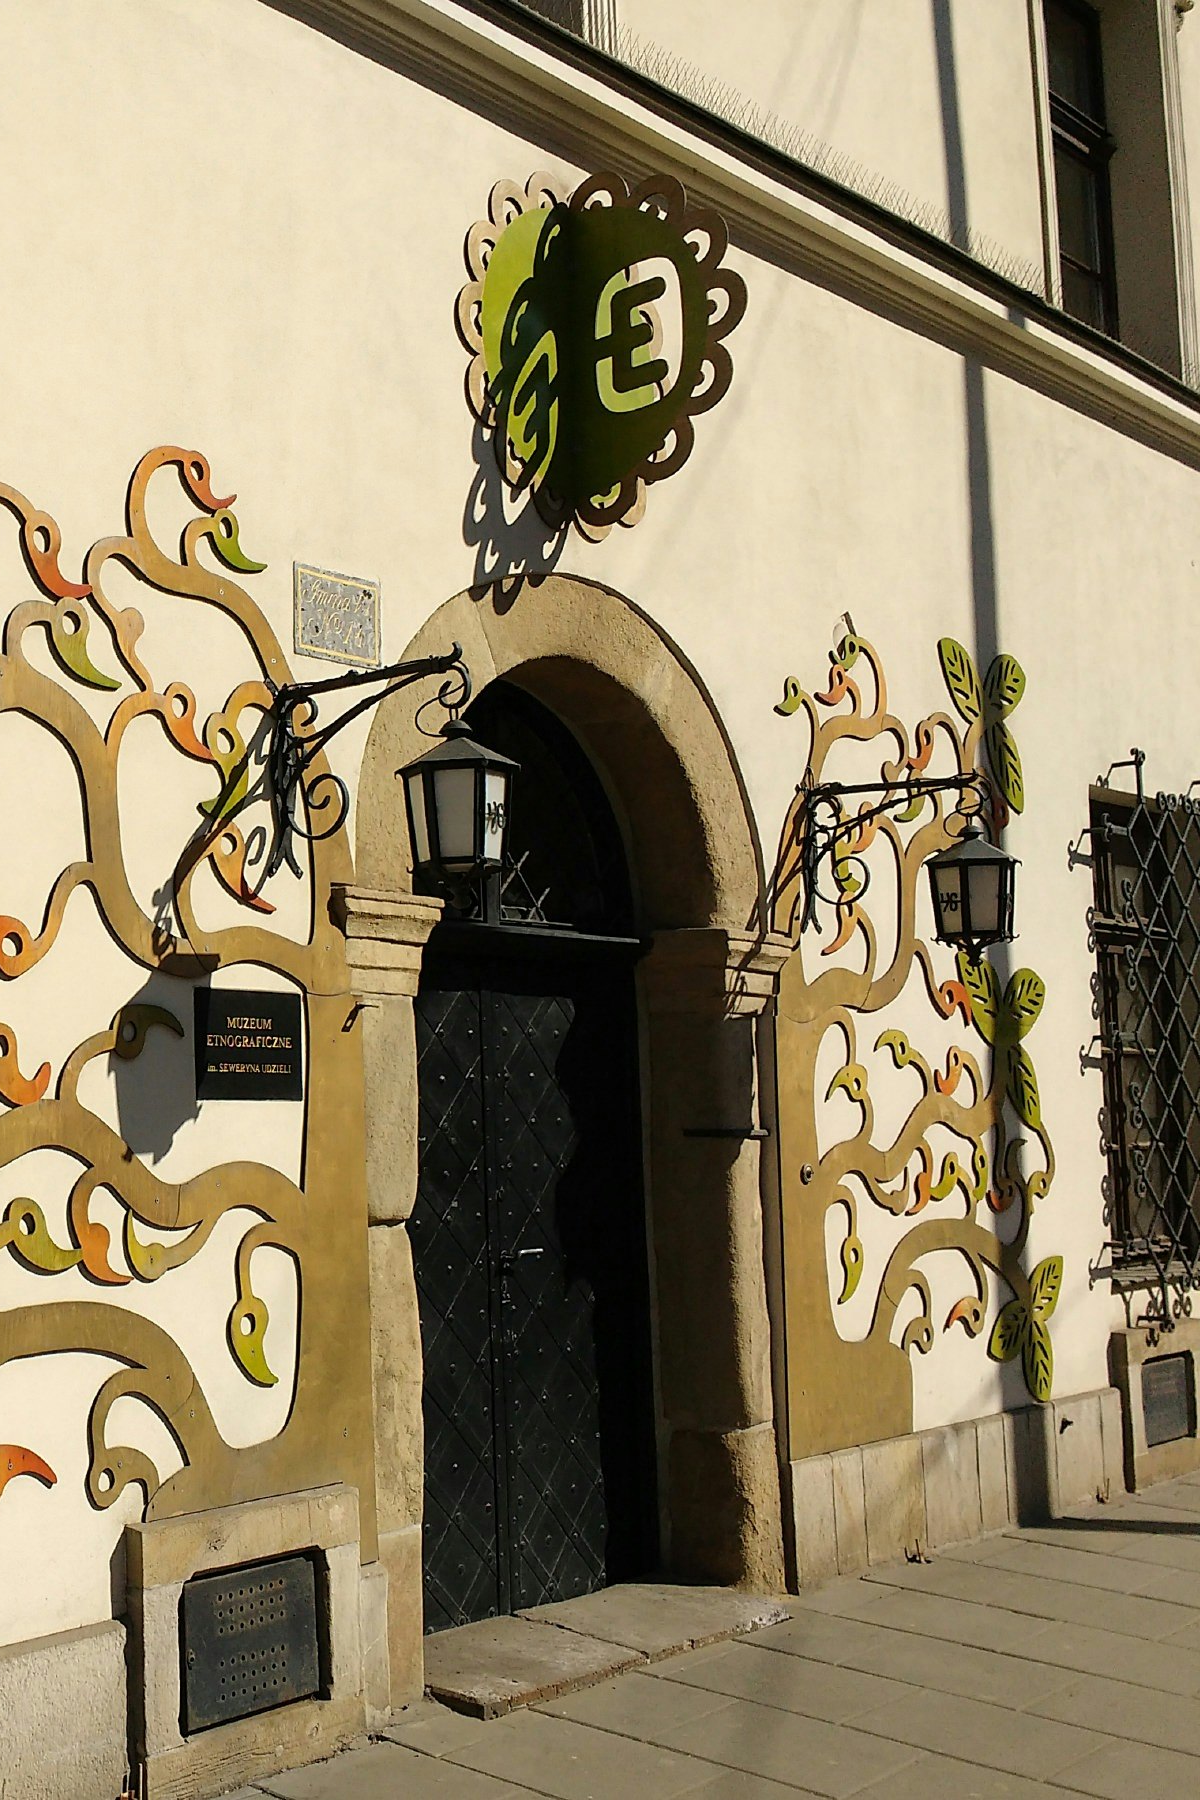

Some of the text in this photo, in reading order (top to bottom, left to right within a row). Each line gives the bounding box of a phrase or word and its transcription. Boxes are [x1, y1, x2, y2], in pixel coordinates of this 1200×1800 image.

[226, 1016, 273, 1030] MUZEUM
[206, 1034, 293, 1049] ETNOGRAFICZNE
[219, 1063, 260, 1073] SEWERYNA
